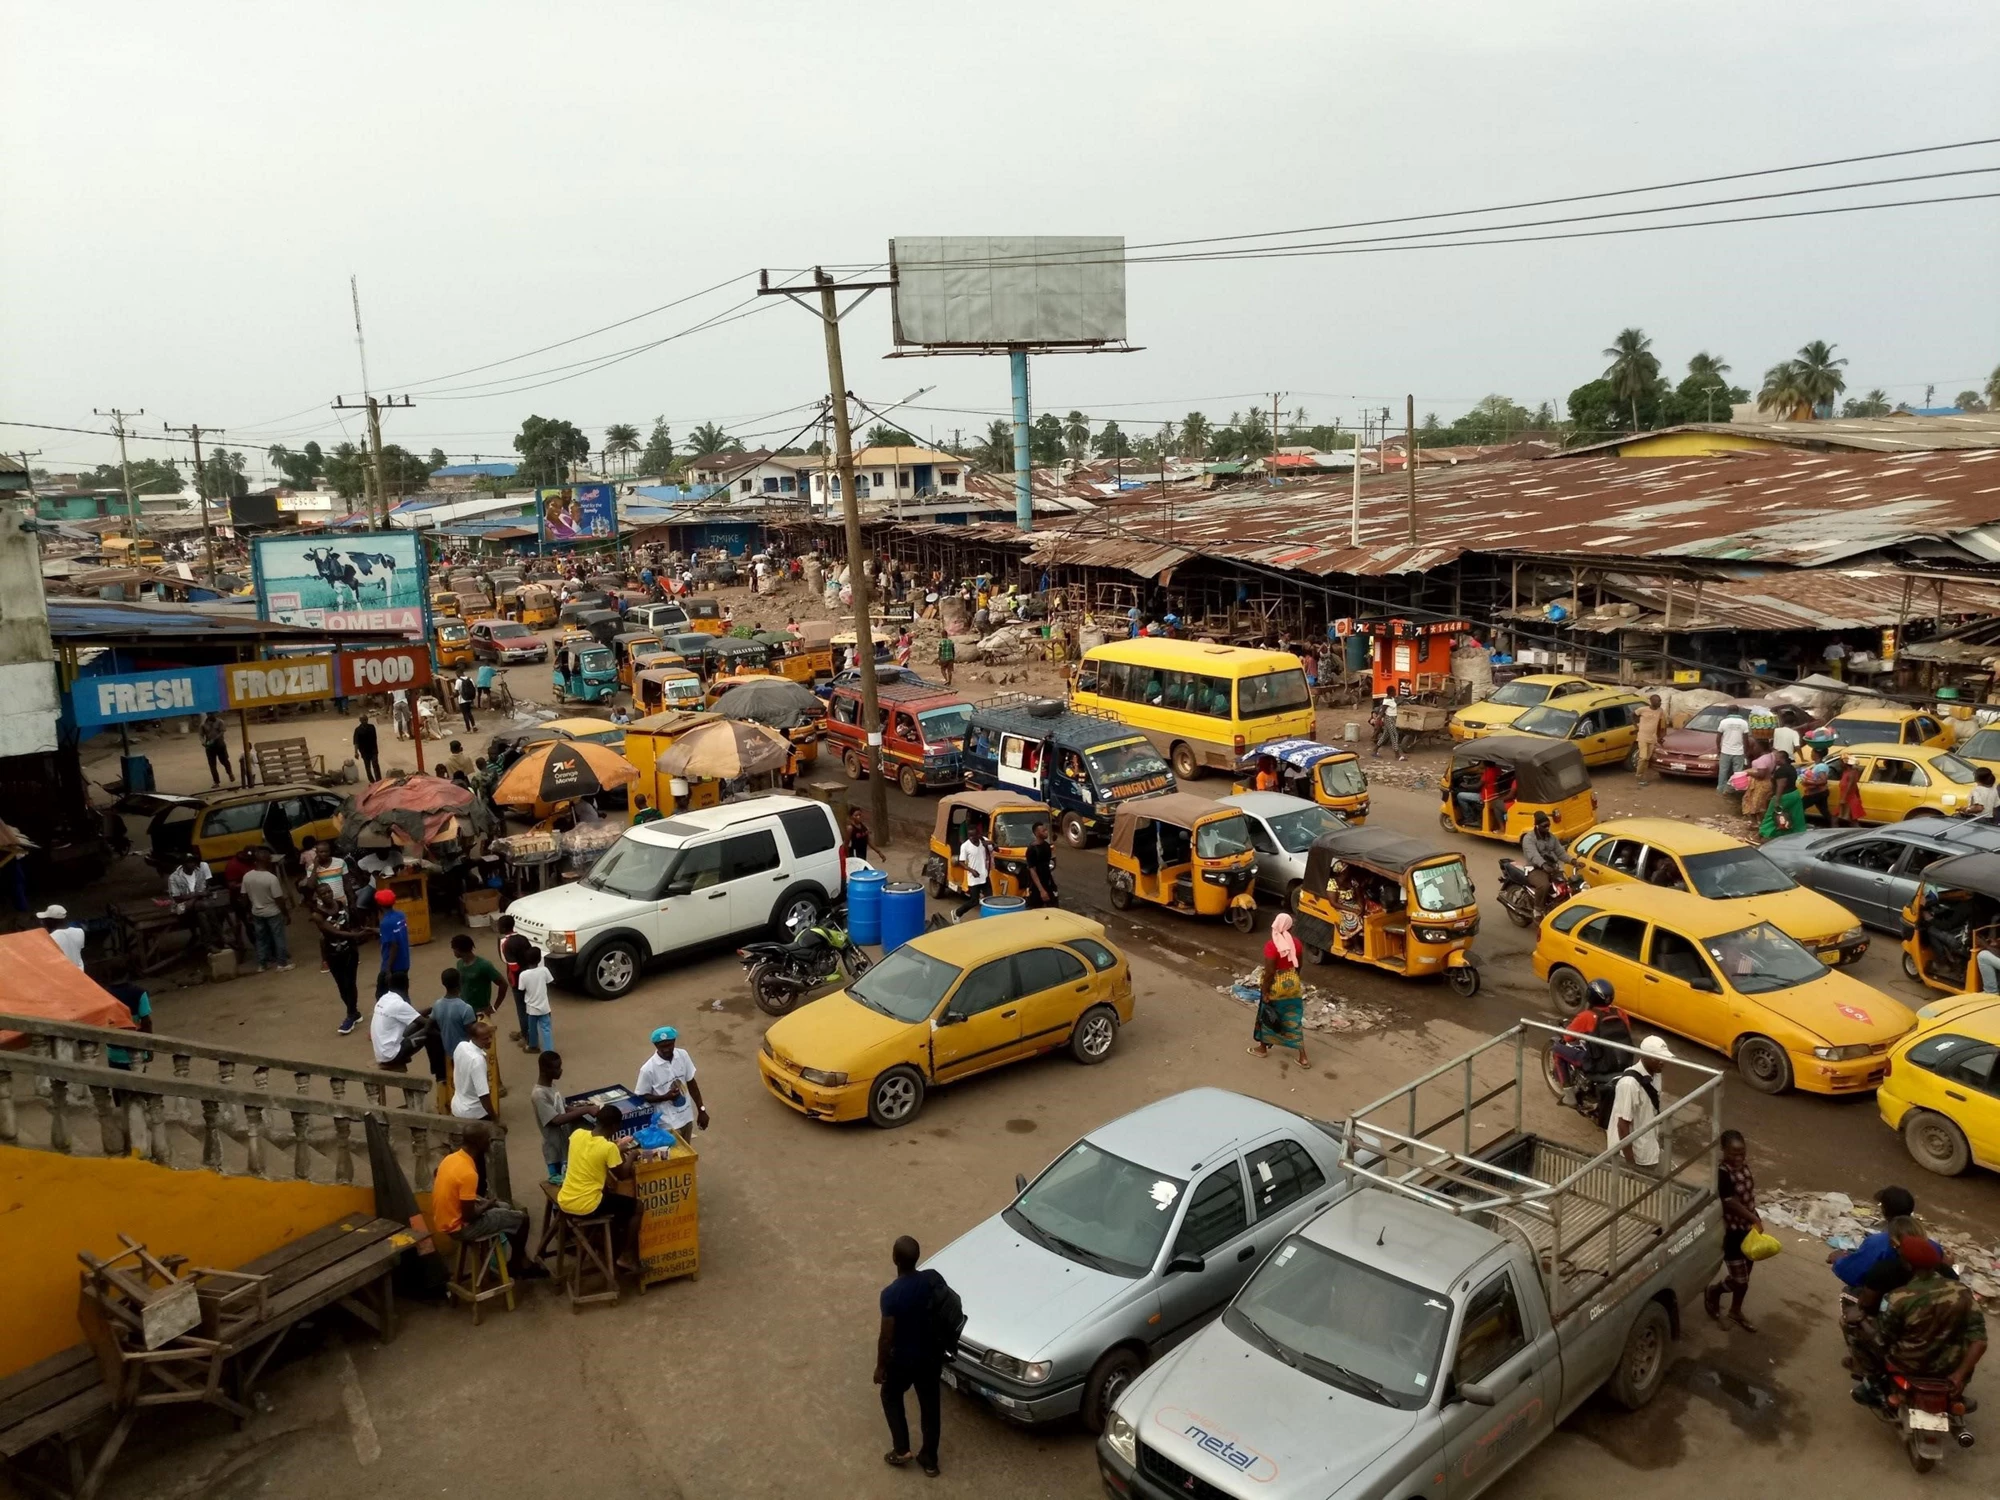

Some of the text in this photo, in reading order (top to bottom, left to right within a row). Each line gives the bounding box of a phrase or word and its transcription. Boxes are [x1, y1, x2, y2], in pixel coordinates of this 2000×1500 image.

[710, 534, 739, 543] JMIKE
[328, 611, 418, 631] OMELA
[98, 655, 414, 716] FRESH FROZEN FOOD
[554, 770, 578, 779] Orange
[555, 776, 578, 785] Money
[1111, 775, 1167, 798] HUNGRY LION
[524, 919, 544, 927] ROVER
[609, 1123, 649, 1142] OBILE
[636, 1173, 692, 1198] MOBILE
[641, 1187, 691, 1212] MONEY
[1184, 1425, 1259, 1472] metal
